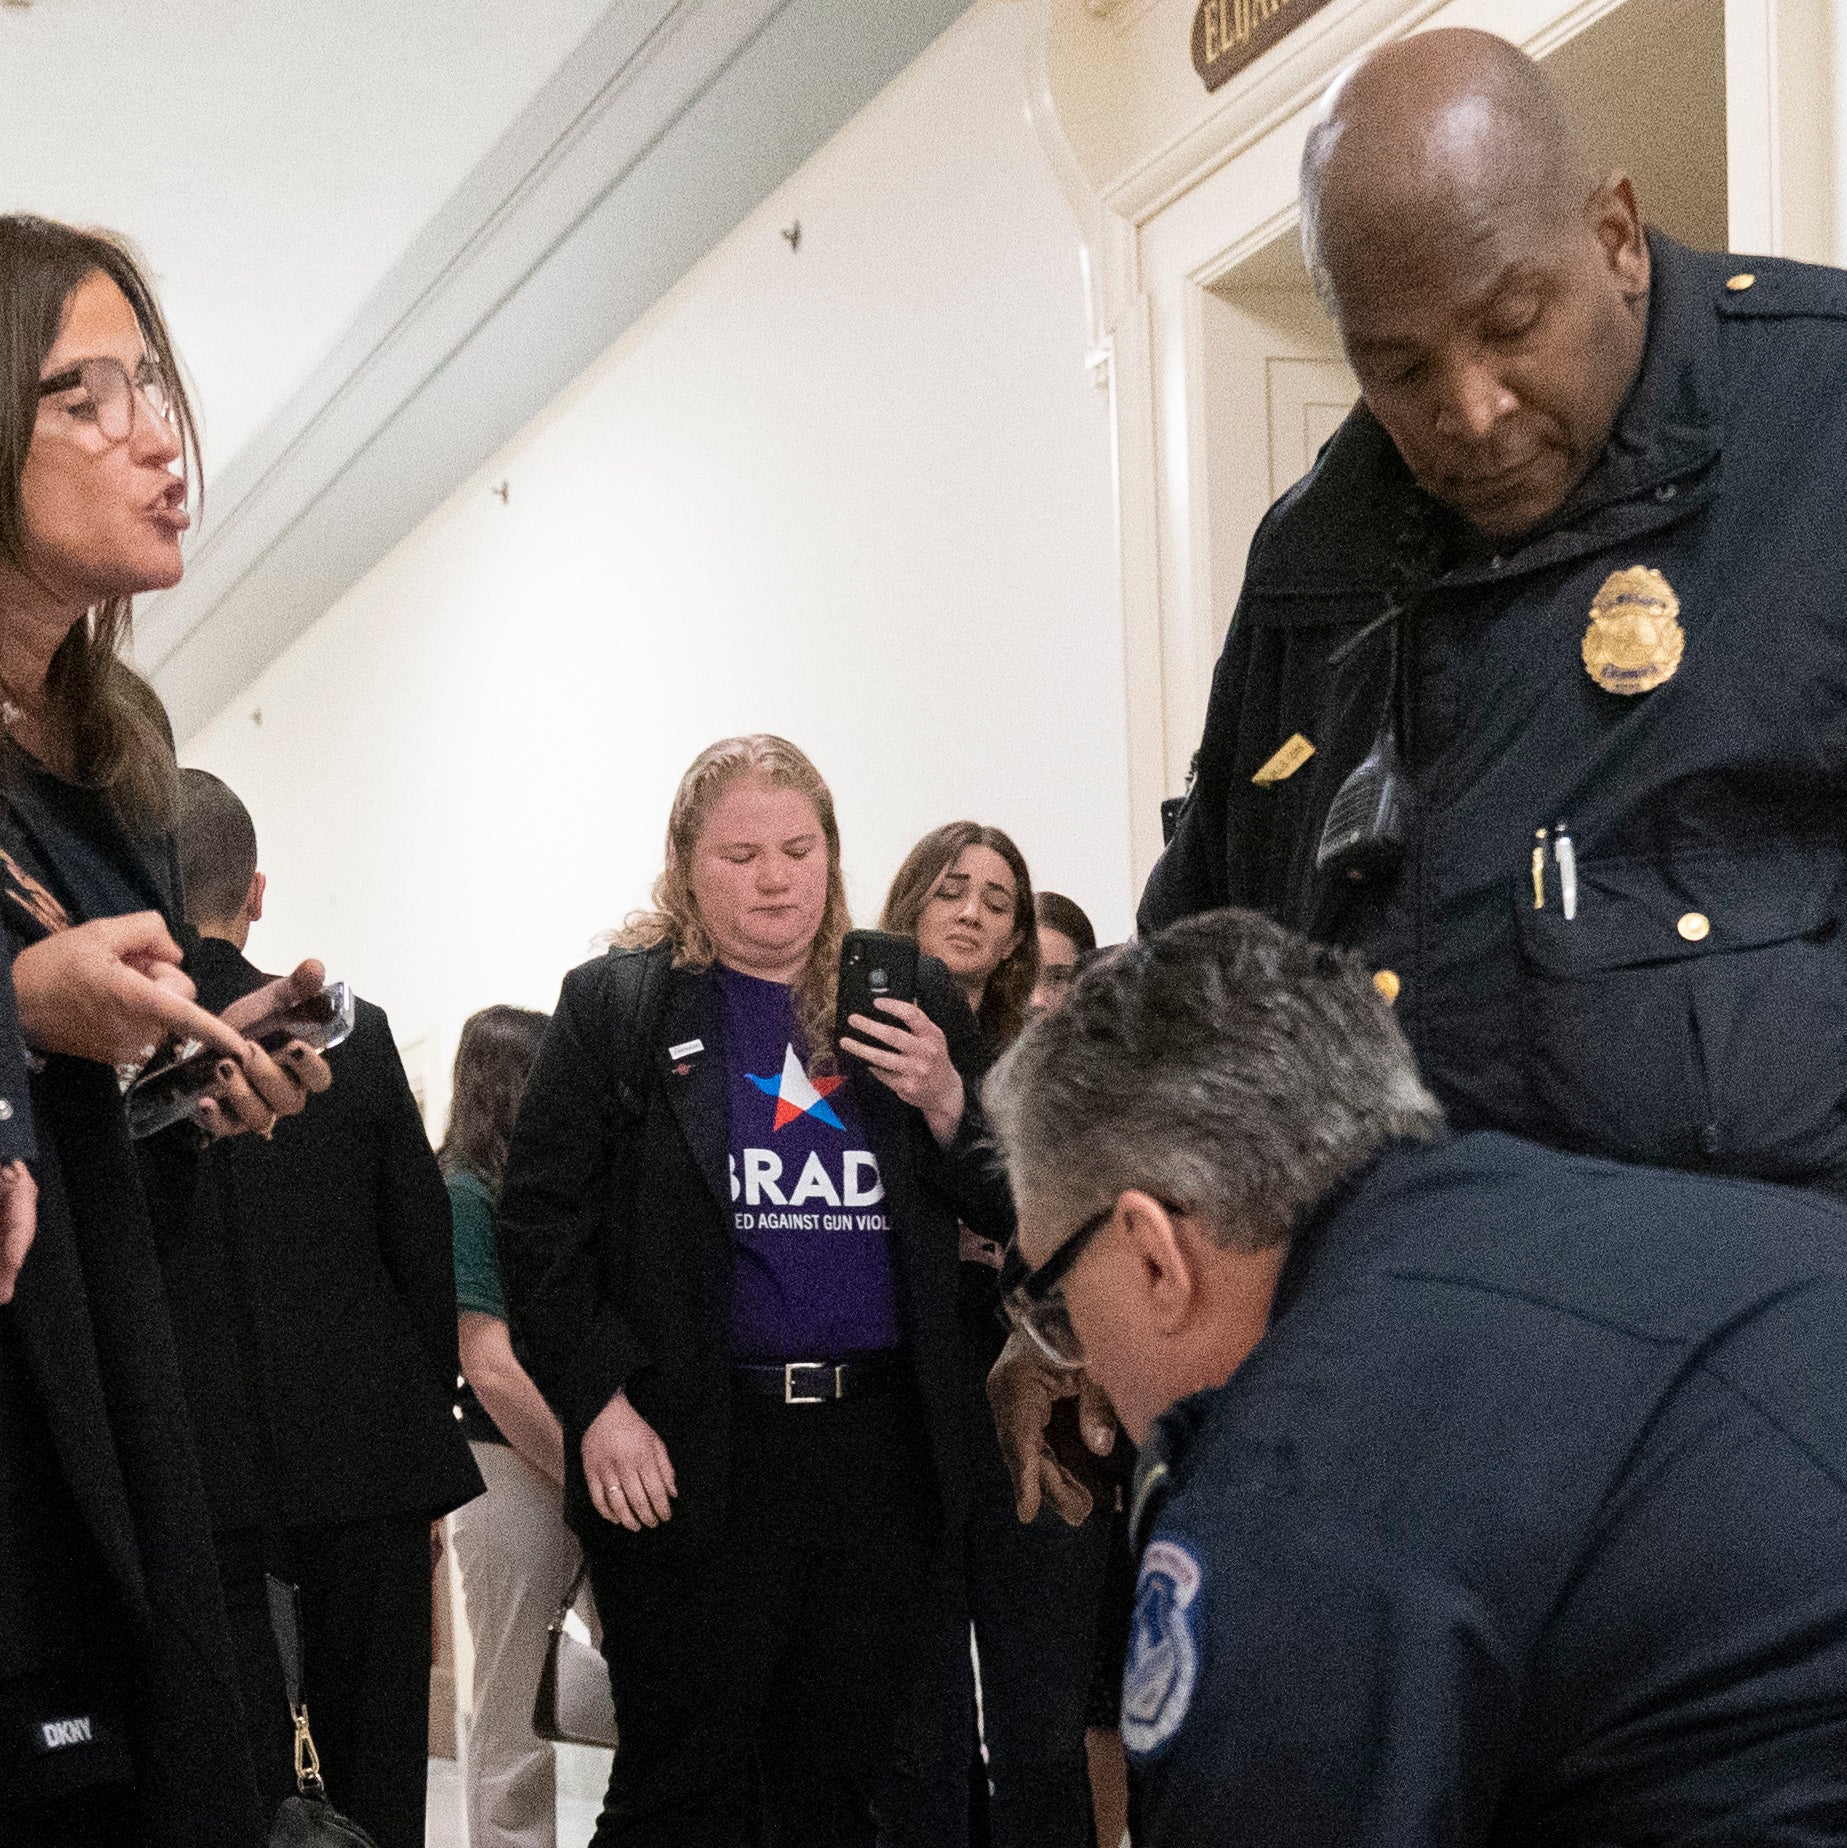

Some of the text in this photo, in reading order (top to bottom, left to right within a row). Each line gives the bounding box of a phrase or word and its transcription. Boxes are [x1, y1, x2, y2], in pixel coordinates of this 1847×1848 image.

[758, 1213, 820, 1231] AGAINST
[822, 1214, 853, 1231] GUN
[41, 1716, 93, 1748] DKNY
